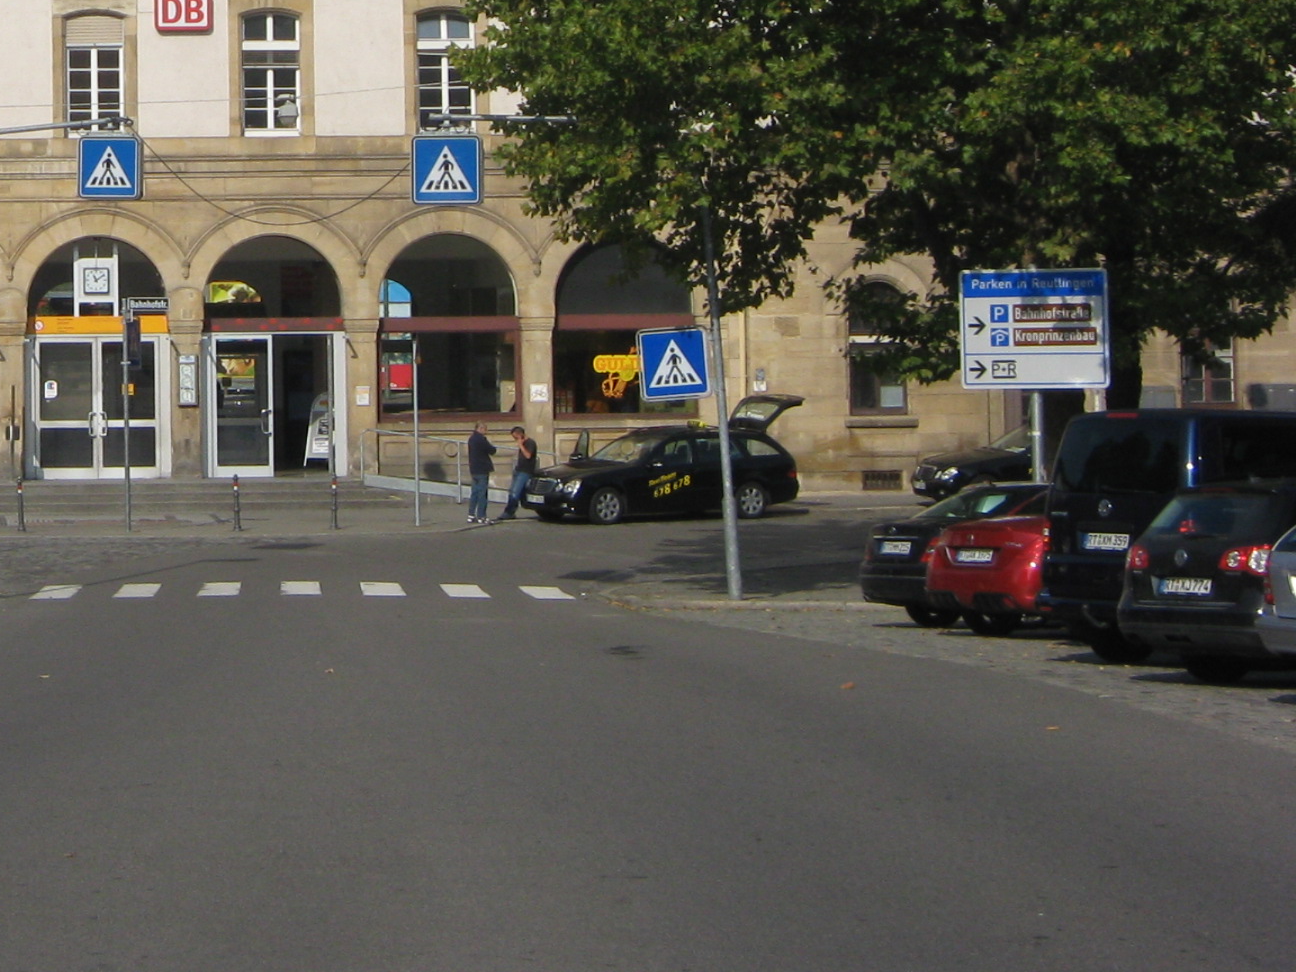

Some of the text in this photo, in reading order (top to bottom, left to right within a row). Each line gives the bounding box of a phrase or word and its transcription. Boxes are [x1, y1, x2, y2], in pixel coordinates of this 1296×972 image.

[971, 277, 1095, 291] Parken in Reutlingen
[994, 306, 1090, 321] P Bahnhofstraße
[1015, 330, 1095, 345] Kronprinzenbau
